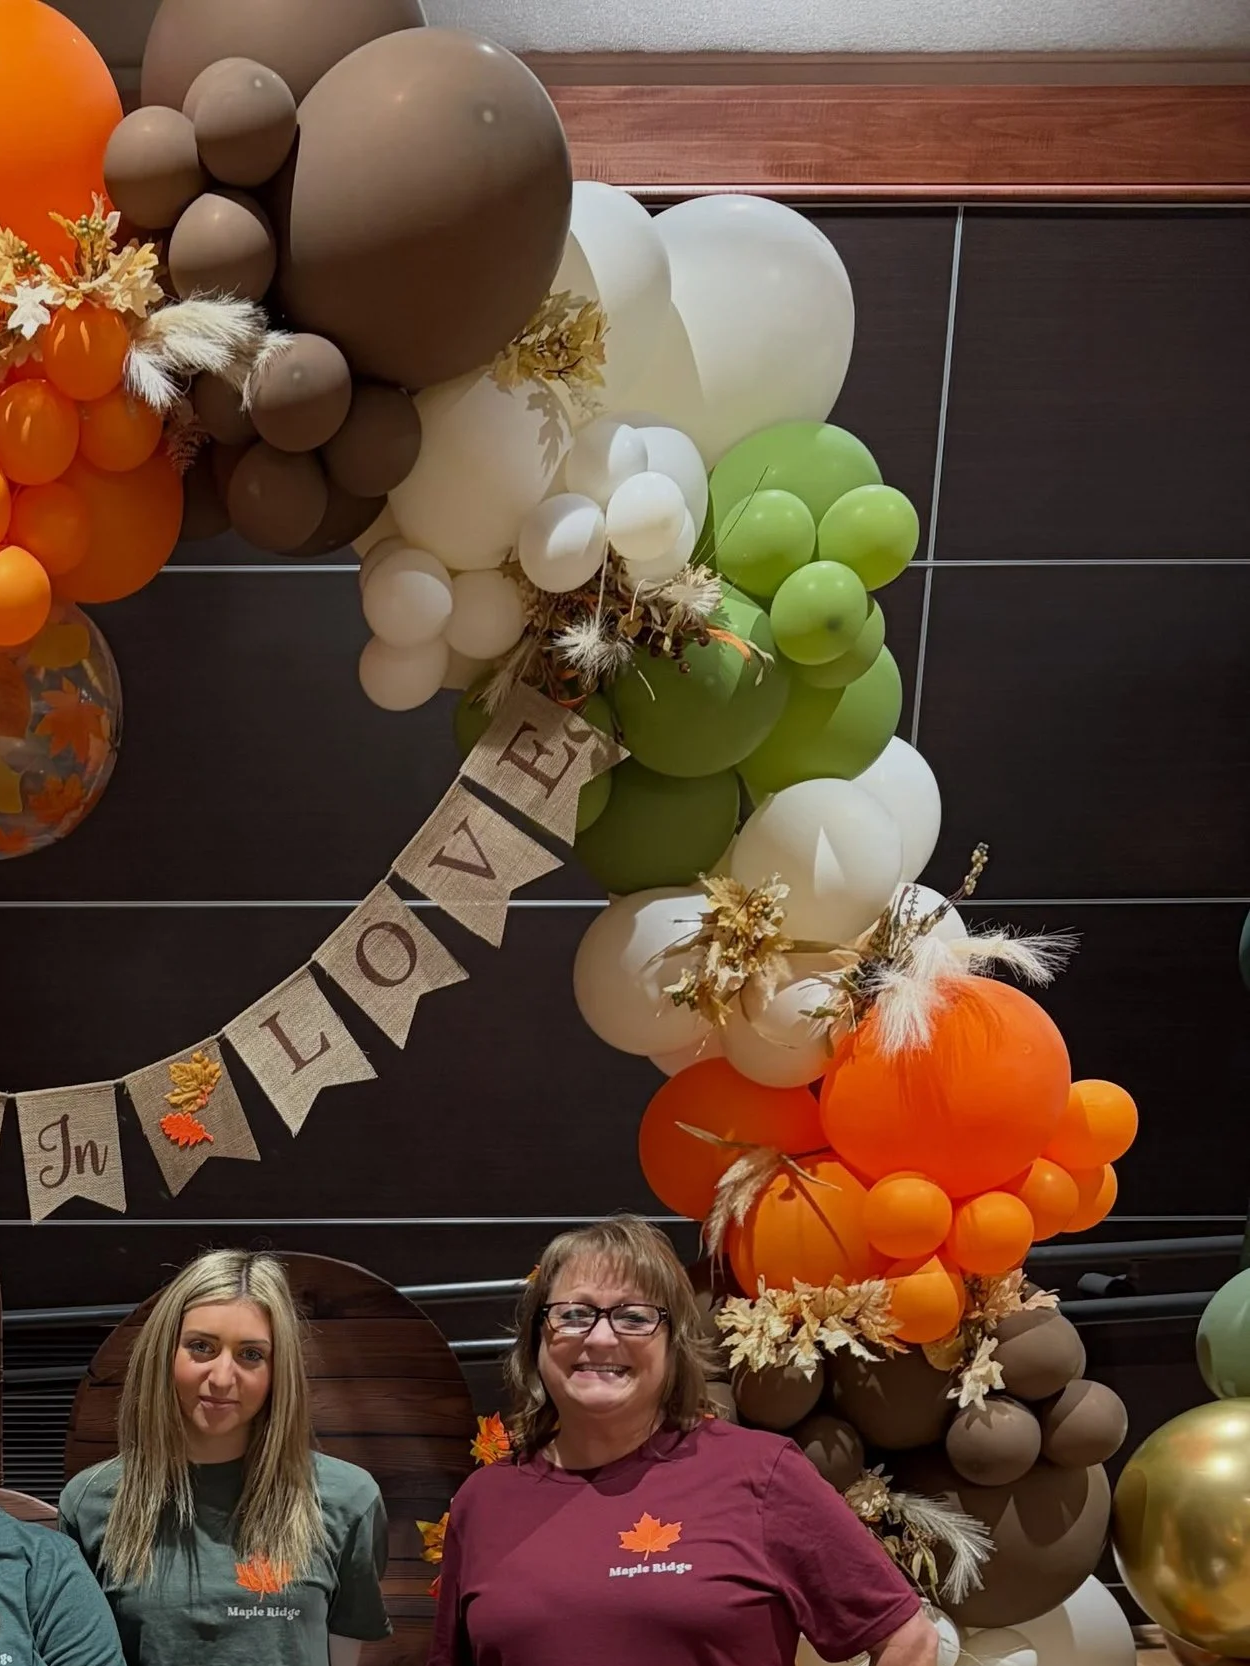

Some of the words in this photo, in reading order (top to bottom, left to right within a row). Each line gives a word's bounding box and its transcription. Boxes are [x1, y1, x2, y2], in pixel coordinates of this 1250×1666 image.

[37, 1112, 108, 1186] In
[256, 718, 578, 1075] LOVE
[608, 1564, 650, 1578] Maple
[651, 1560, 693, 1574] Ridge
[227, 1606, 264, 1619] Maple
[266, 1605, 301, 1619] Ridge
